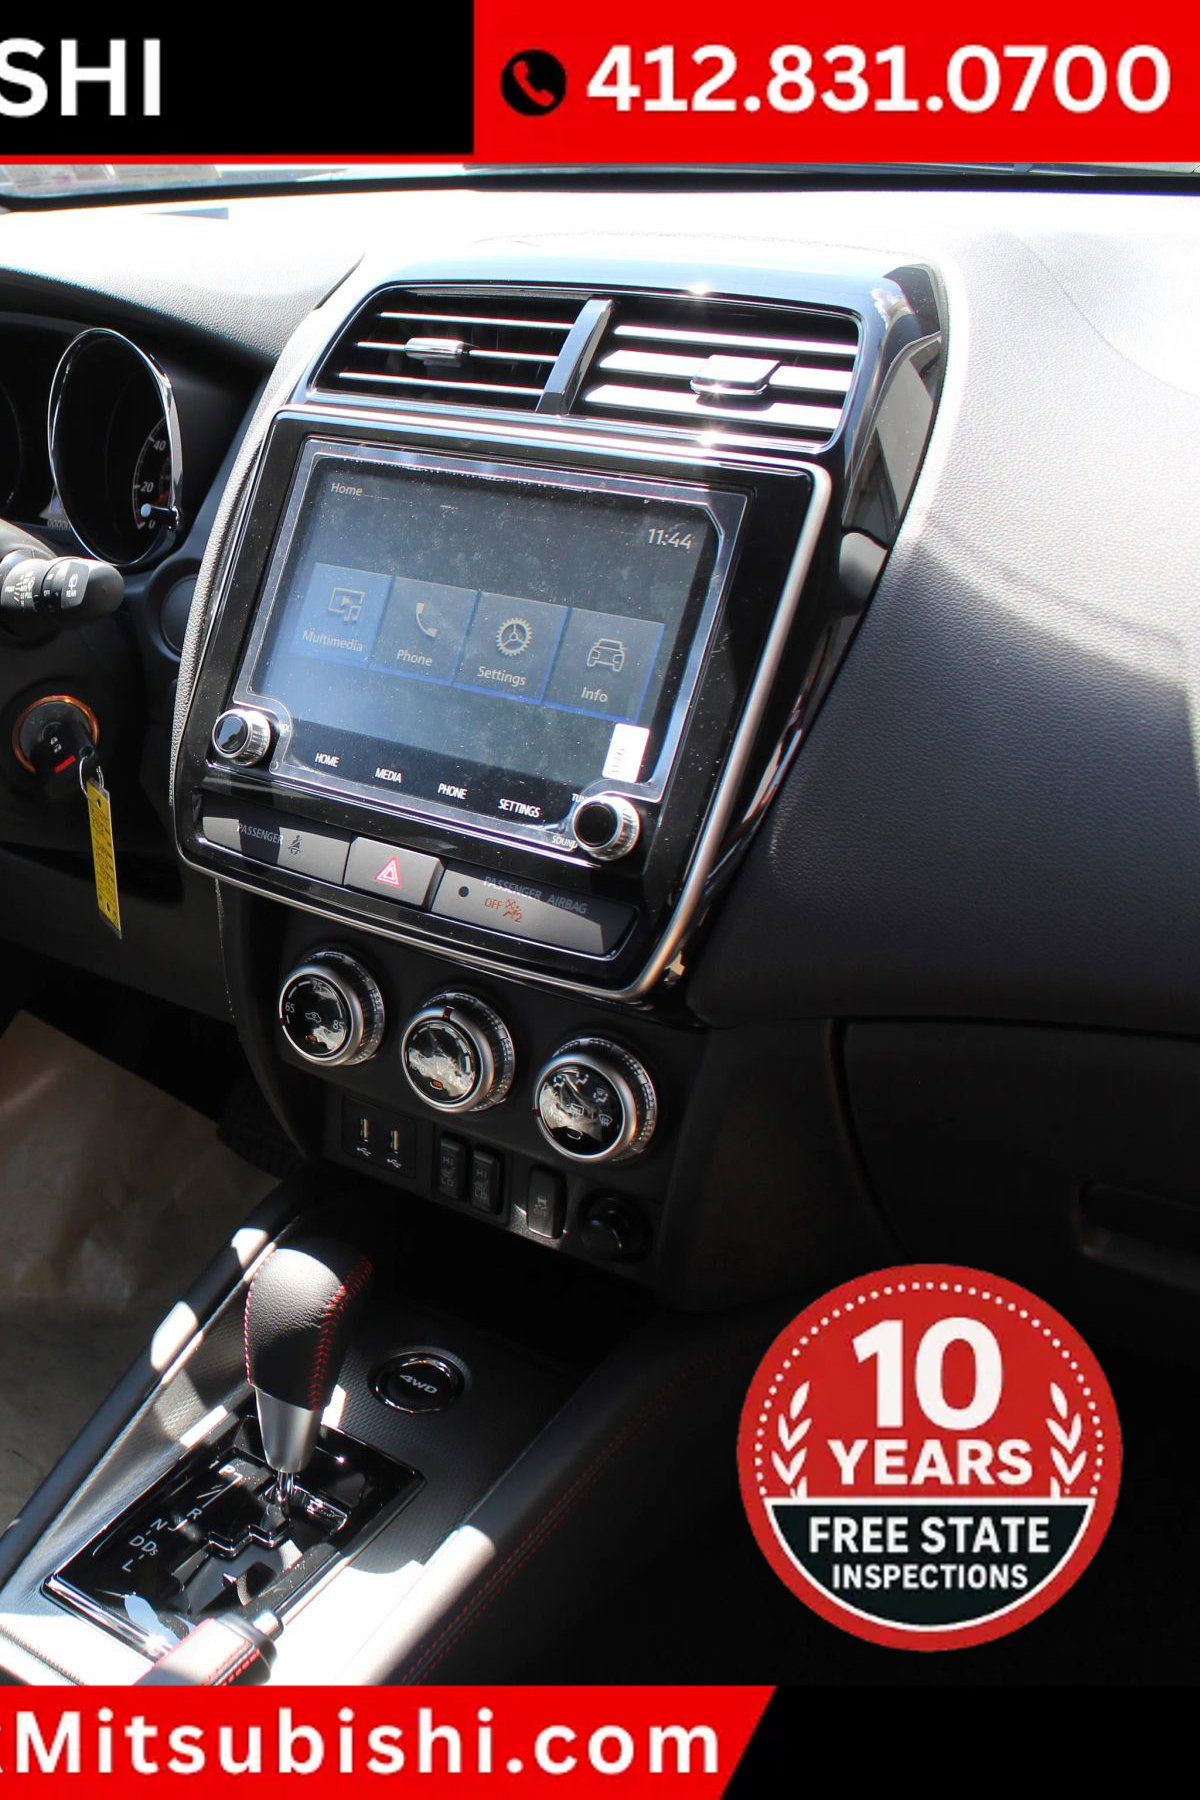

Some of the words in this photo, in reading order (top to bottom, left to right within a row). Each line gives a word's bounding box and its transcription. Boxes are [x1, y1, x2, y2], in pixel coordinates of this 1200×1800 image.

[153, 440, 167, 451] 40
[141, 481, 154, 493] 20
[330, 482, 364, 496] Home
[648, 528, 692, 550] 11:44
[302, 630, 364, 652] Multimedia
[396, 649, 433, 667] Phone
[477, 665, 528, 688] Settings
[580, 686, 609, 703] Info
[315, 752, 341, 768] HOME
[374, 767, 403, 784] MEDIA
[438, 782, 468, 800] PHONE
[498, 798, 543, 818] SETTINGS
[237, 823, 284, 845] PASSENGER
[483, 875, 543, 900] PASSENGER
[546, 894, 589, 915] AIRBAG
[484, 897, 502, 910] OFF
[285, 1002, 296, 1014] 65
[400, 1374, 439, 1394] 4WD
[186, 1507, 203, 1520] R
[149, 1518, 169, 1531] N
[128, 1535, 145, 1547] D
[121, 1559, 134, 1573] L
